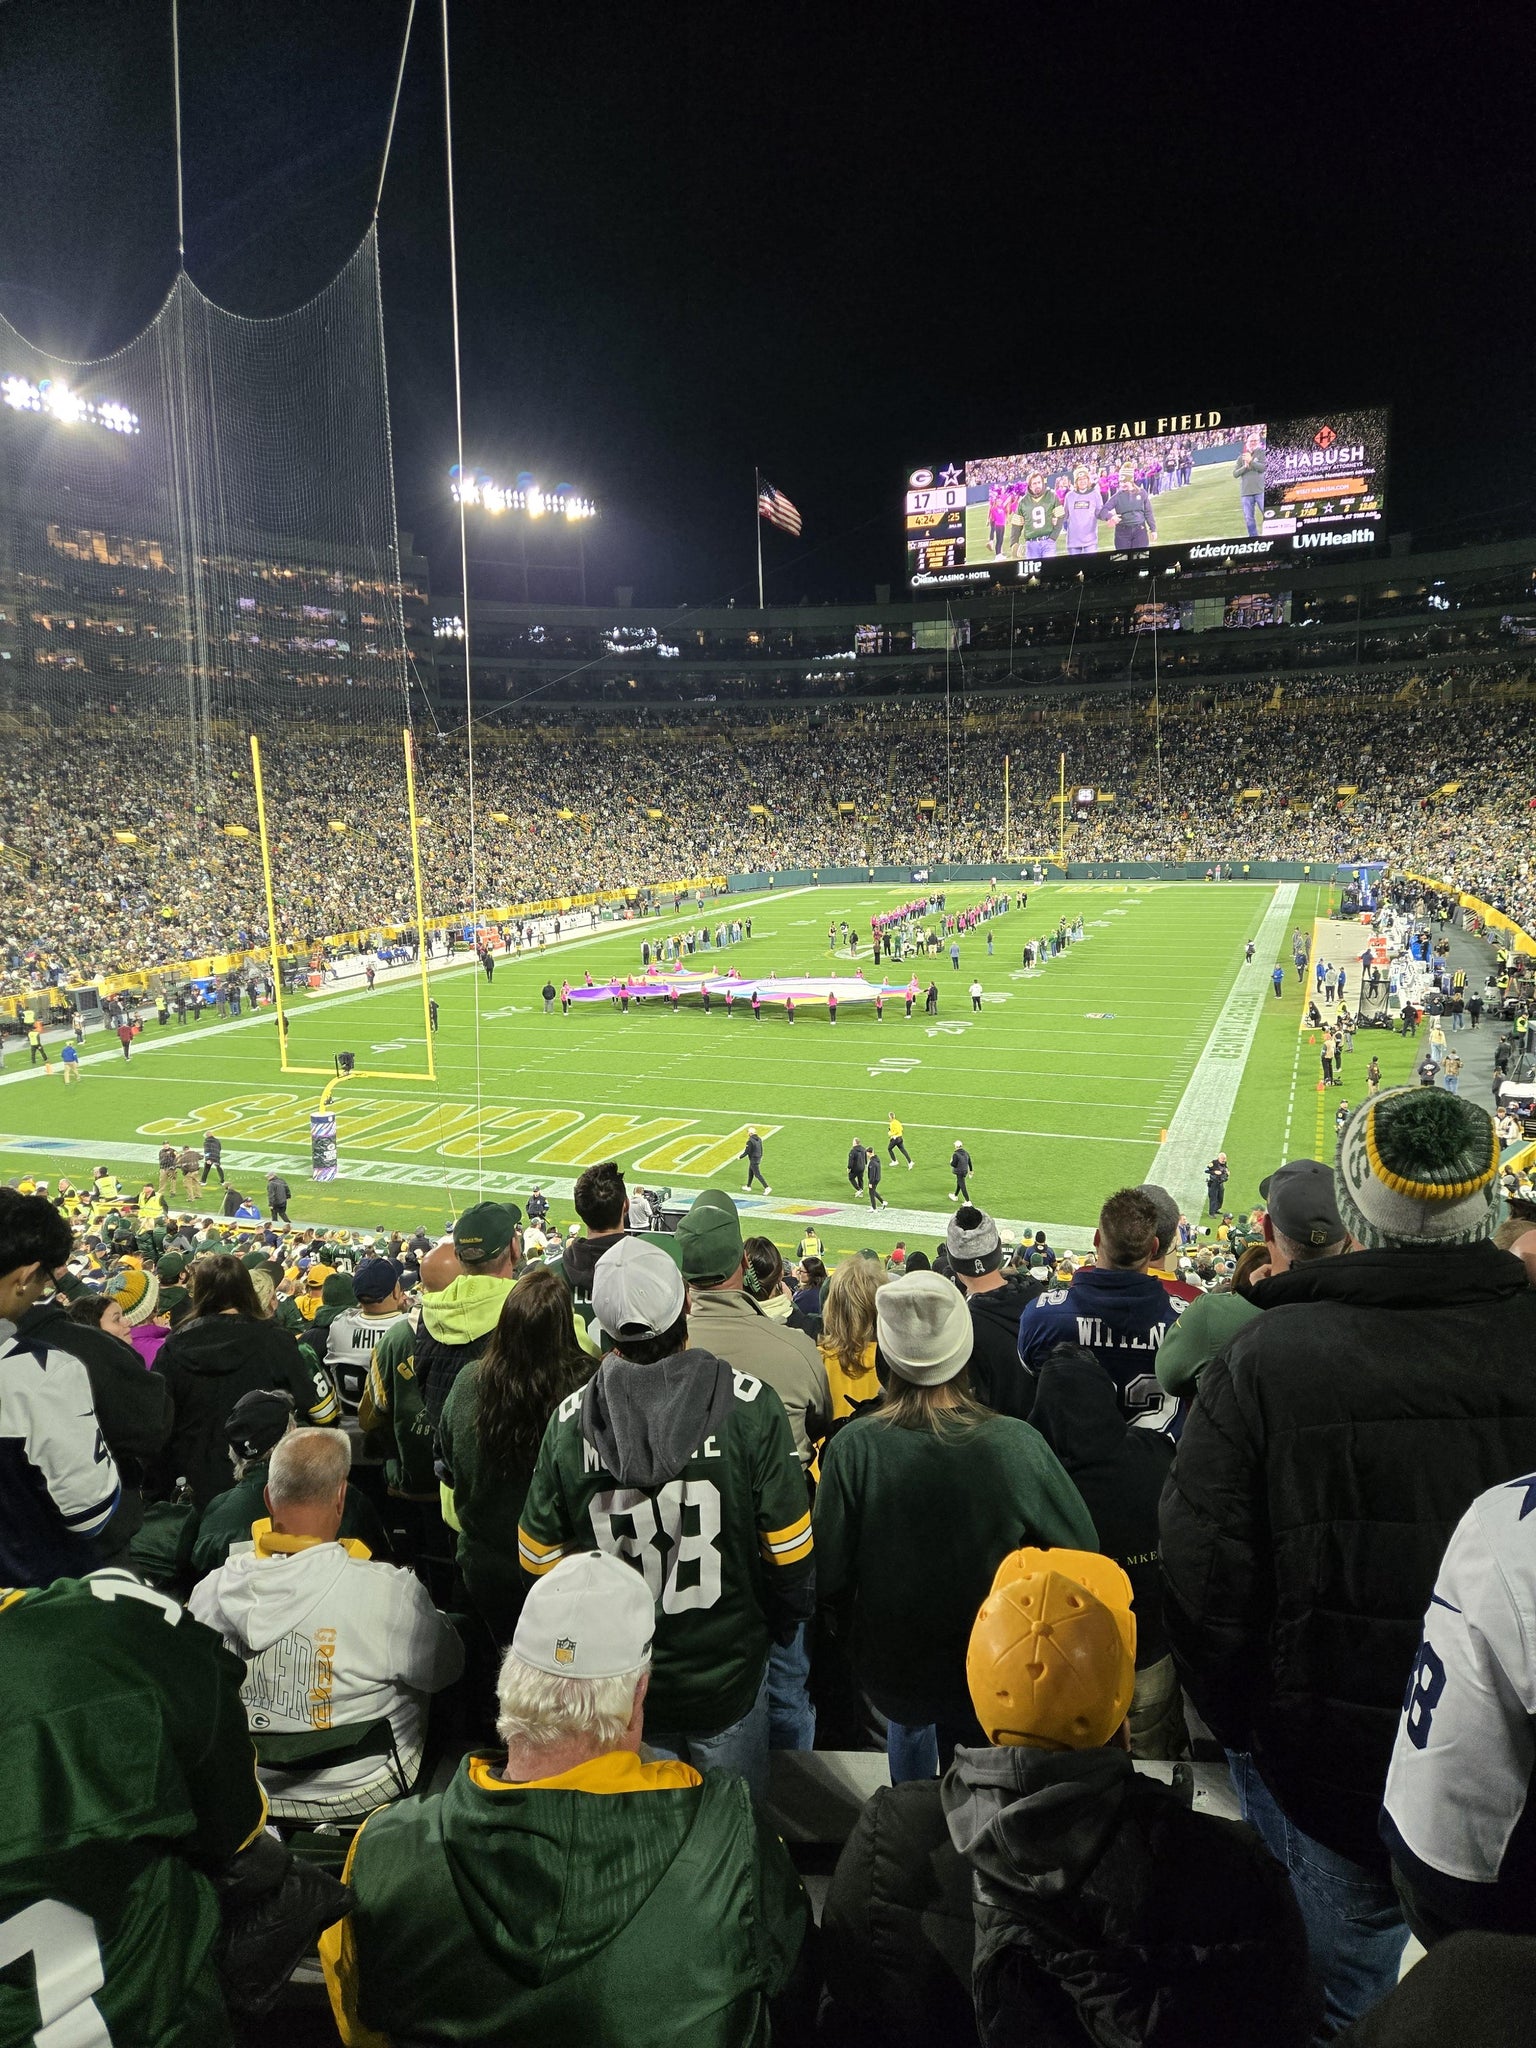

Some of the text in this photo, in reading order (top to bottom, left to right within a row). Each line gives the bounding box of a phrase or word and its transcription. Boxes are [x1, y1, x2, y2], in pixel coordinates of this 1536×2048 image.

[1046, 411, 1222, 449] LAMBEAU FIELD
[1285, 446, 1364, 469] HABUSH
[914, 491, 955, 509] 17 0
[915, 514, 935, 525] 4:24
[1031, 506, 1046, 529] 9
[1189, 540, 1274, 559] ticketmaster
[938, 573, 965, 582] CASINO
[968, 571, 990, 579] HOTEL
[1018, 560, 1043, 577] Lite
[924, 1020, 974, 1036] 20
[1208, 1027, 1249, 1060] CANCER
[867, 1057, 922, 1074] 10
[136, 1093, 784, 1178] PACKERS
[352, 1328, 386, 1349] WHIT
[588, 1479, 722, 1615] 88
[1126, 1550, 1158, 1566] MKE
[1402, 1640, 1447, 1750] 8
